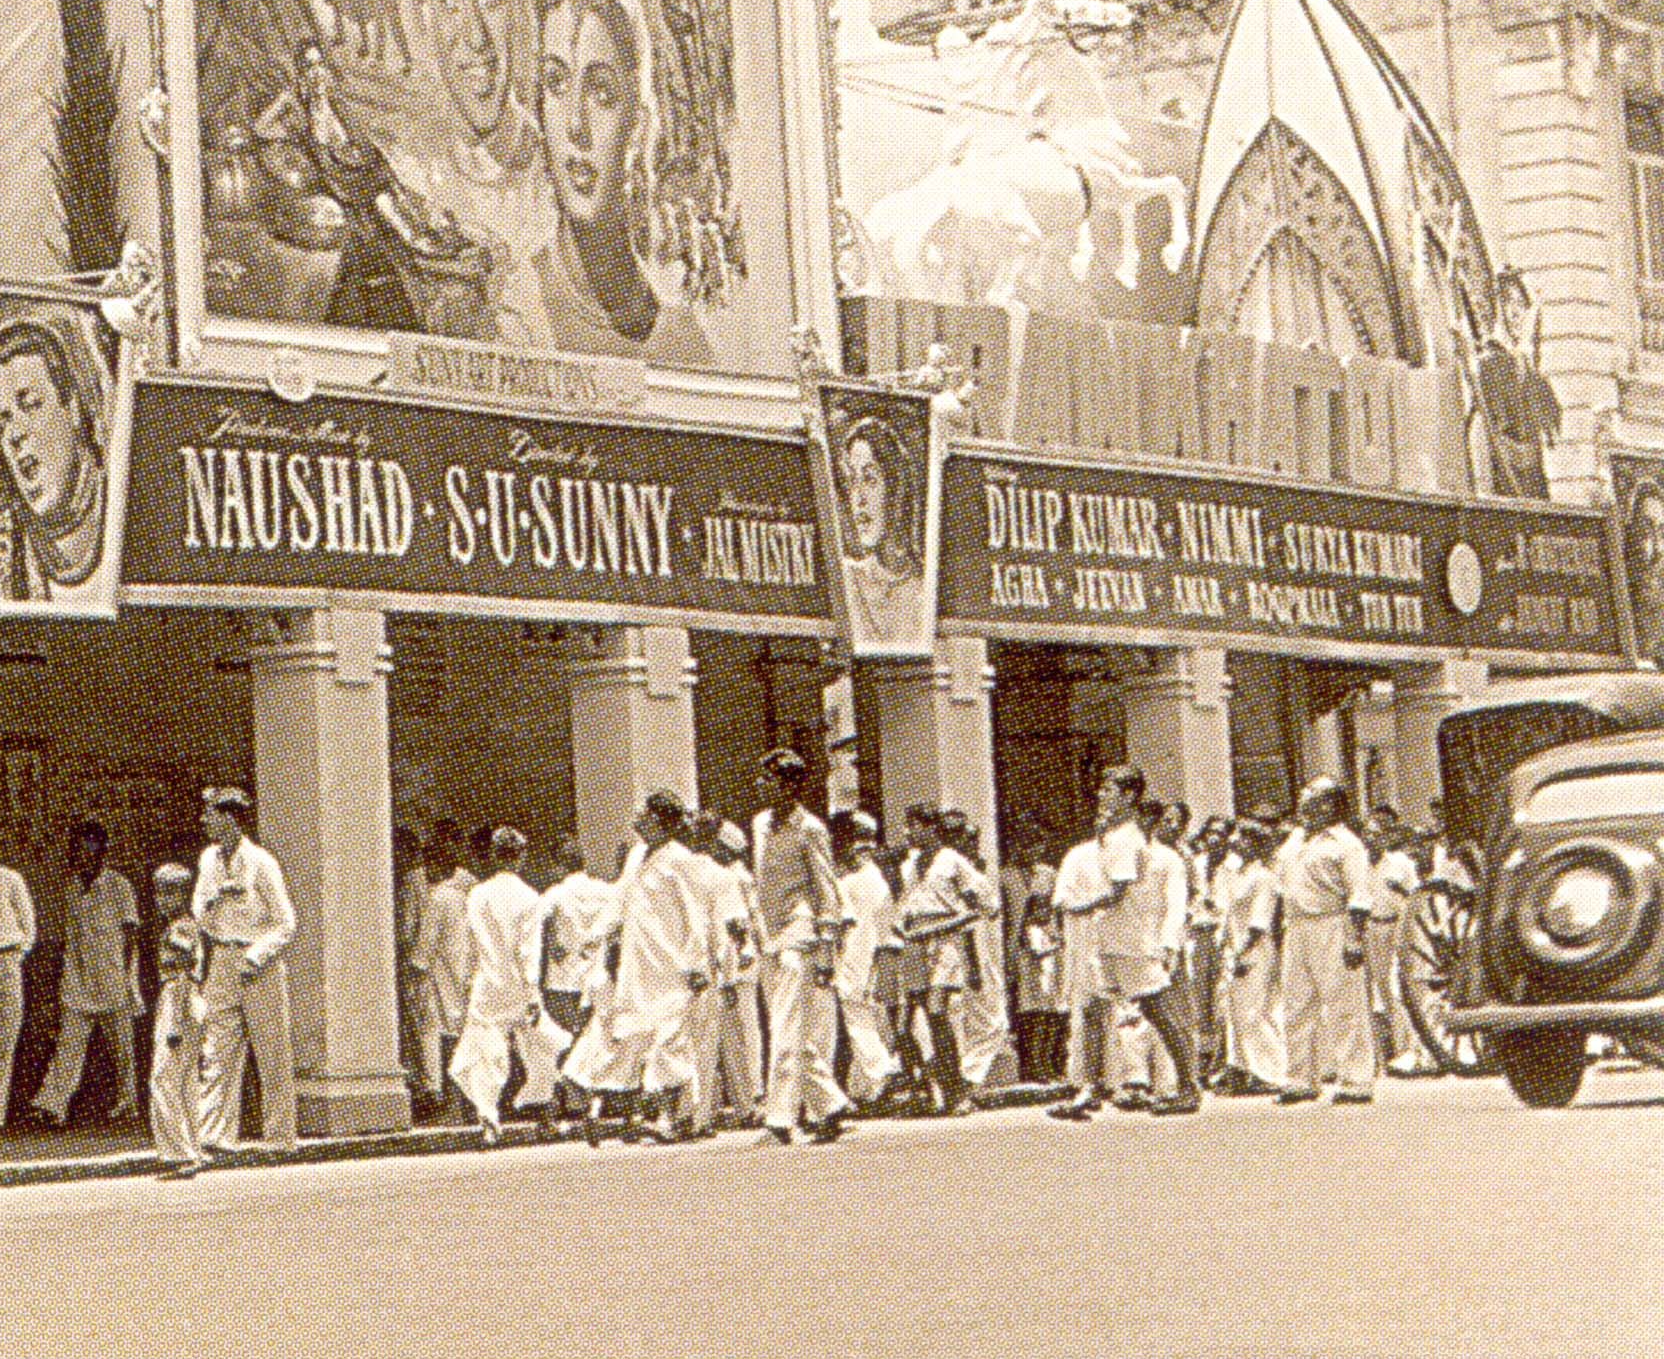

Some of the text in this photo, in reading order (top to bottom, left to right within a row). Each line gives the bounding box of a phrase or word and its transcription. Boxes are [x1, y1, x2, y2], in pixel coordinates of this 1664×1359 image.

[180, 446, 414, 558] NAUSHAD
[984, 482, 1063, 553] DILIP
[1067, 492, 1165, 561] KUMAR
[1177, 500, 1265, 569] NIMMI
[989, 562, 1051, 609] AGHA
[1071, 567, 1147, 612] JEEVAN
